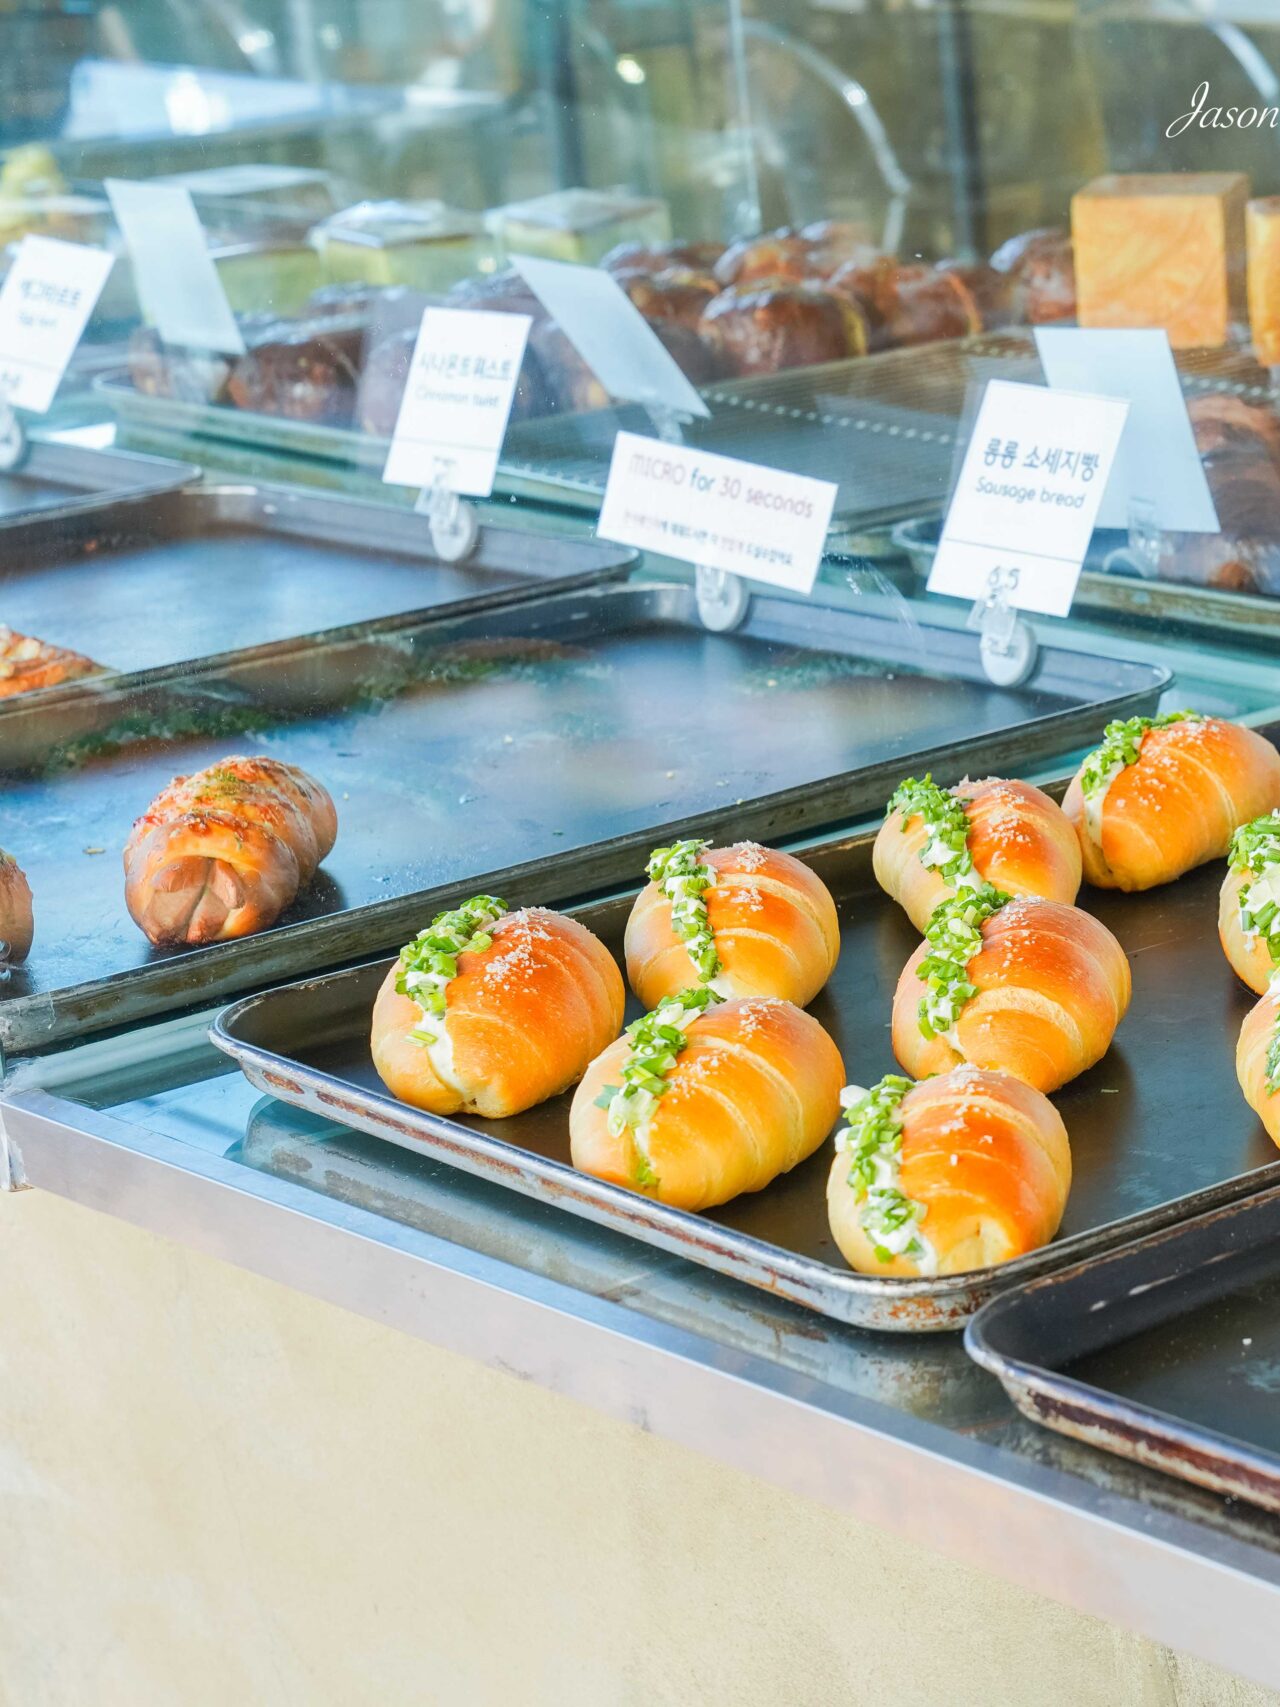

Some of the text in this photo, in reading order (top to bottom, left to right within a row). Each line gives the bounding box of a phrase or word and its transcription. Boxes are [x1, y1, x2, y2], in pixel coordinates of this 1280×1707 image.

[1022, 445, 1100, 483] 소세지빵
[689, 467, 715, 492] for
[719, 475, 742, 500] 30
[746, 486, 815, 519] seconds
[976, 475, 1087, 509] Sausage bread
